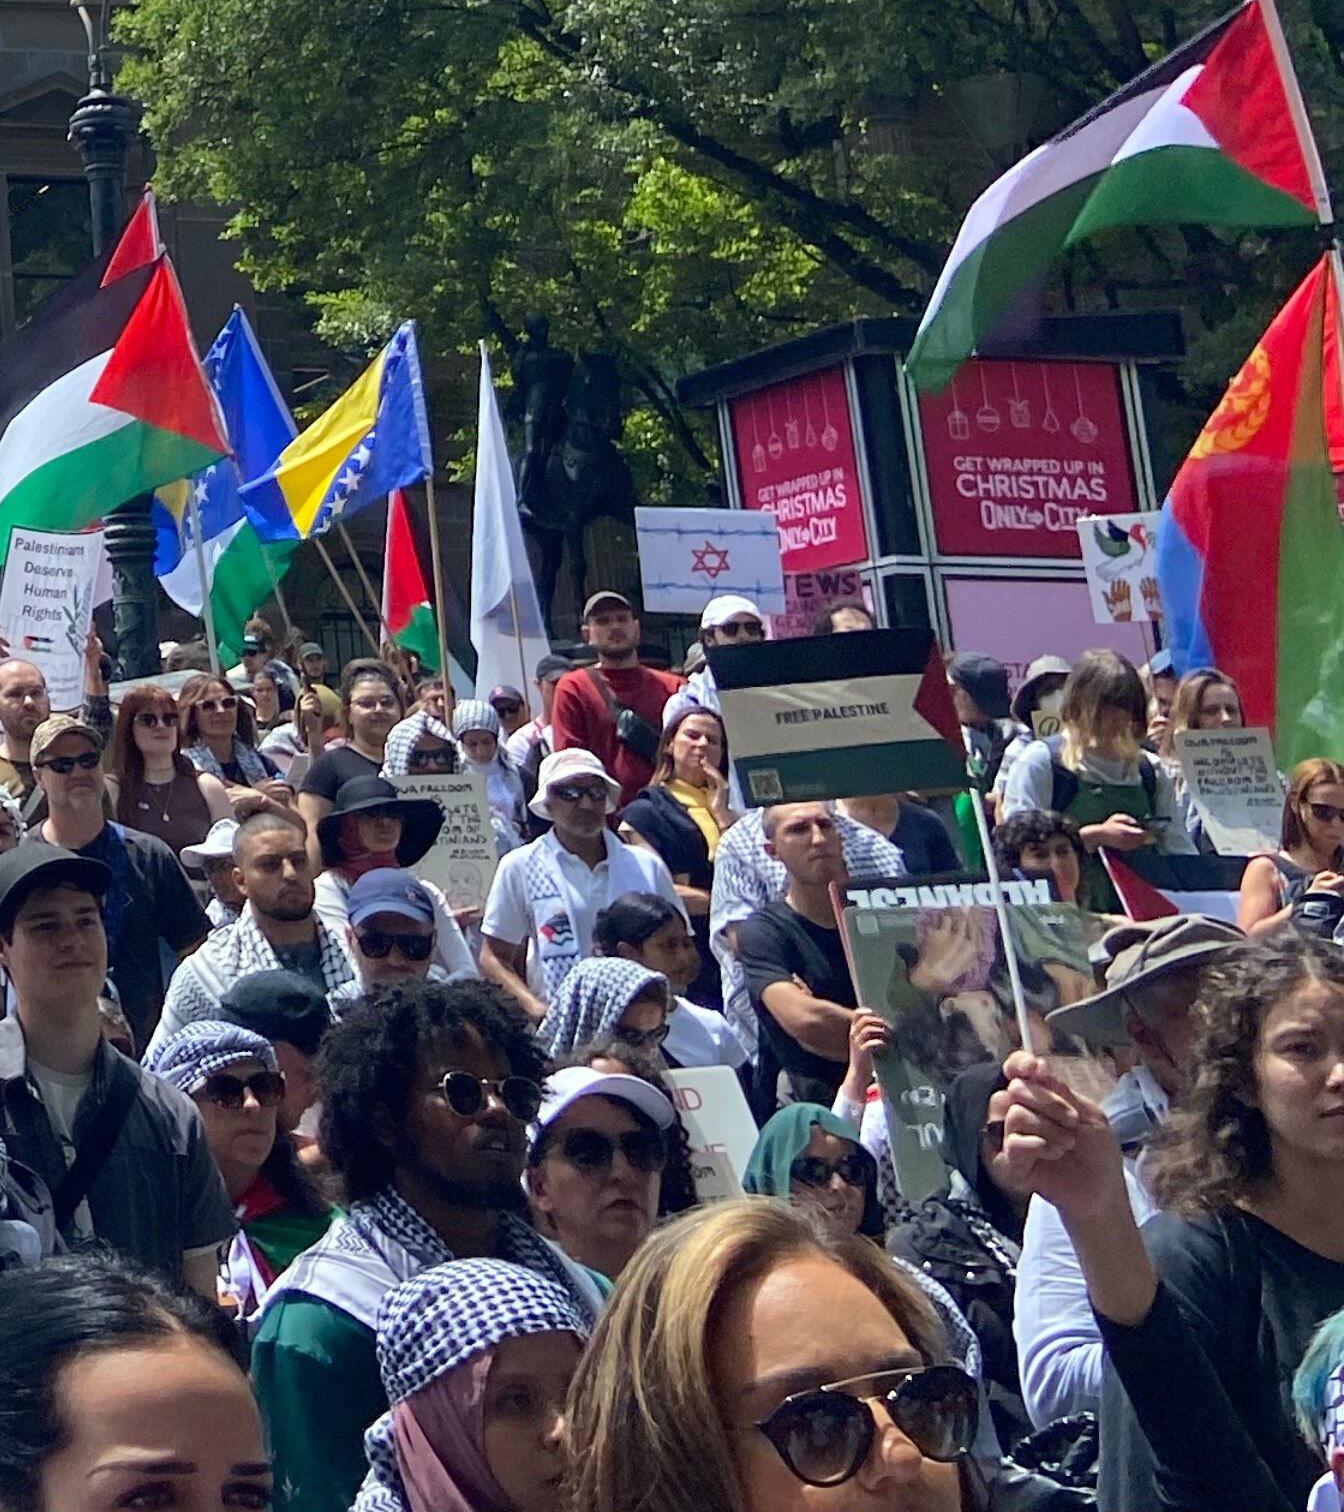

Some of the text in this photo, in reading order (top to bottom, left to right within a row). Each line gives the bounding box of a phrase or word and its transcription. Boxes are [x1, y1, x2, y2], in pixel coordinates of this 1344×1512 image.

[953, 455, 1105, 476] GET WRAPPED UP IN
[956, 473, 1107, 502] CHRISTMAS
[14, 537, 85, 557] Palestinians
[24, 561, 73, 578] Deserve
[24, 583, 67, 600] Human
[21, 604, 63, 622] Rights
[775, 702, 891, 725] FREE PALESTINE
